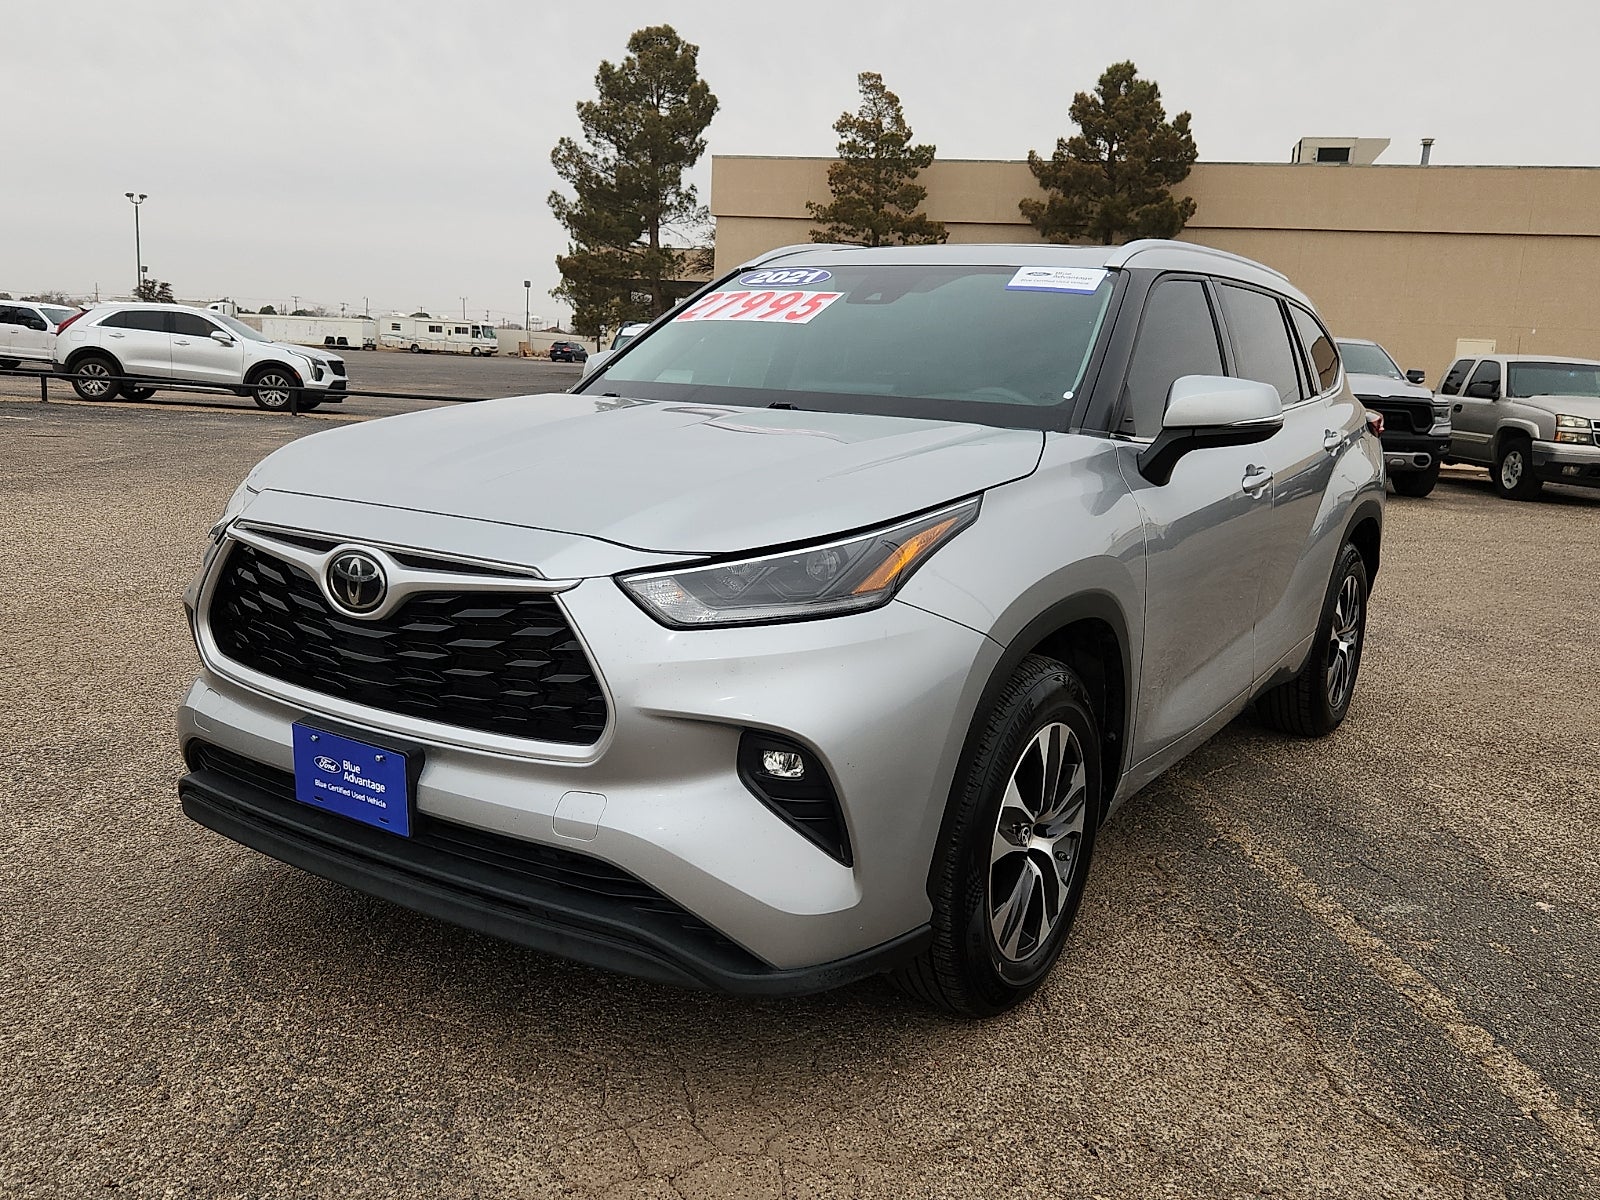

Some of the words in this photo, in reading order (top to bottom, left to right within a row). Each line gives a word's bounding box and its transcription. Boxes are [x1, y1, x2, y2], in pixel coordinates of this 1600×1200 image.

[747, 268, 819, 284] 2021
[676, 291, 838, 321] 27995
[342, 760, 361, 774] Blue
[343, 772, 386, 793] Advantage
[314, 779, 327, 789] Blue
[327, 783, 351, 797] Certified
[351, 790, 366, 802] Used
[366, 795, 387, 809] Vehicle
